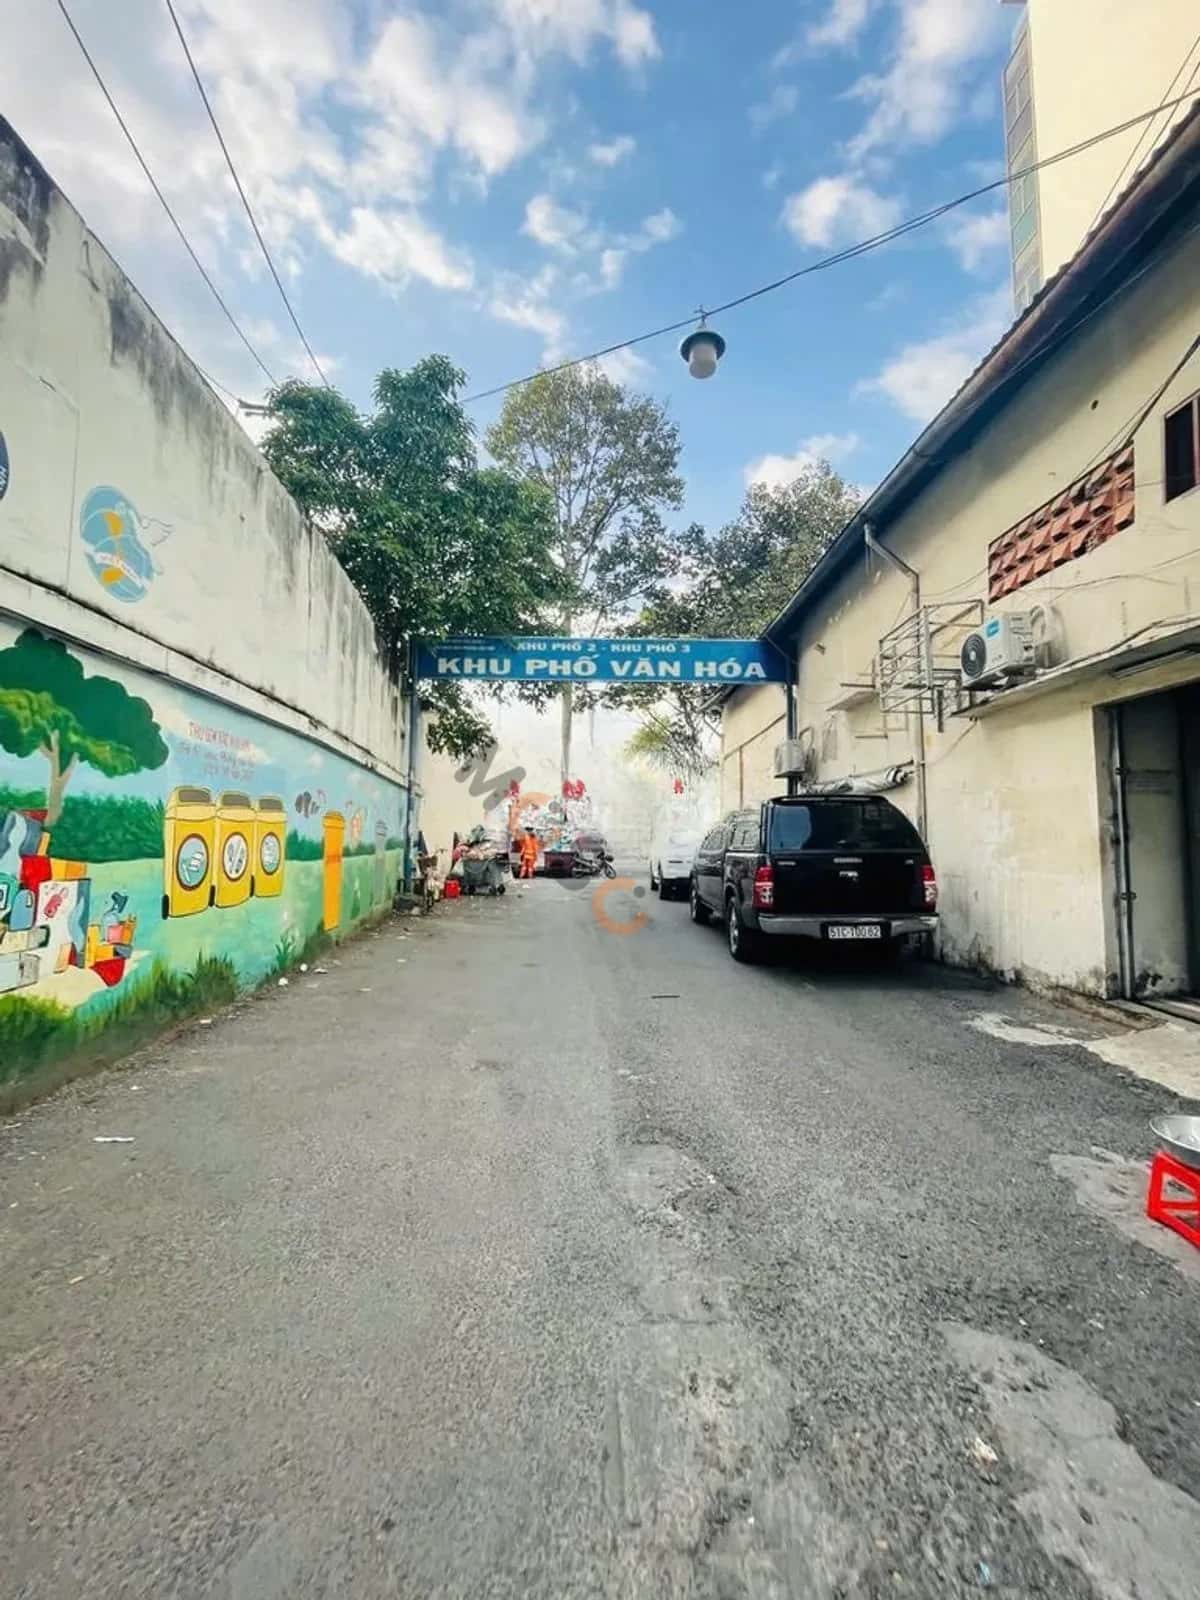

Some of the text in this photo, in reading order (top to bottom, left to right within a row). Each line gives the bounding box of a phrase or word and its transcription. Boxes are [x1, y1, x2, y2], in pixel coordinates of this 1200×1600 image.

[516, 641, 547, 651] KHU
[587, 642, 597, 652] 2
[610, 643, 642, 653] KHU
[680, 644, 691, 653] 3
[437, 653, 767, 678] KHU PHỐ VĂN HÓA
